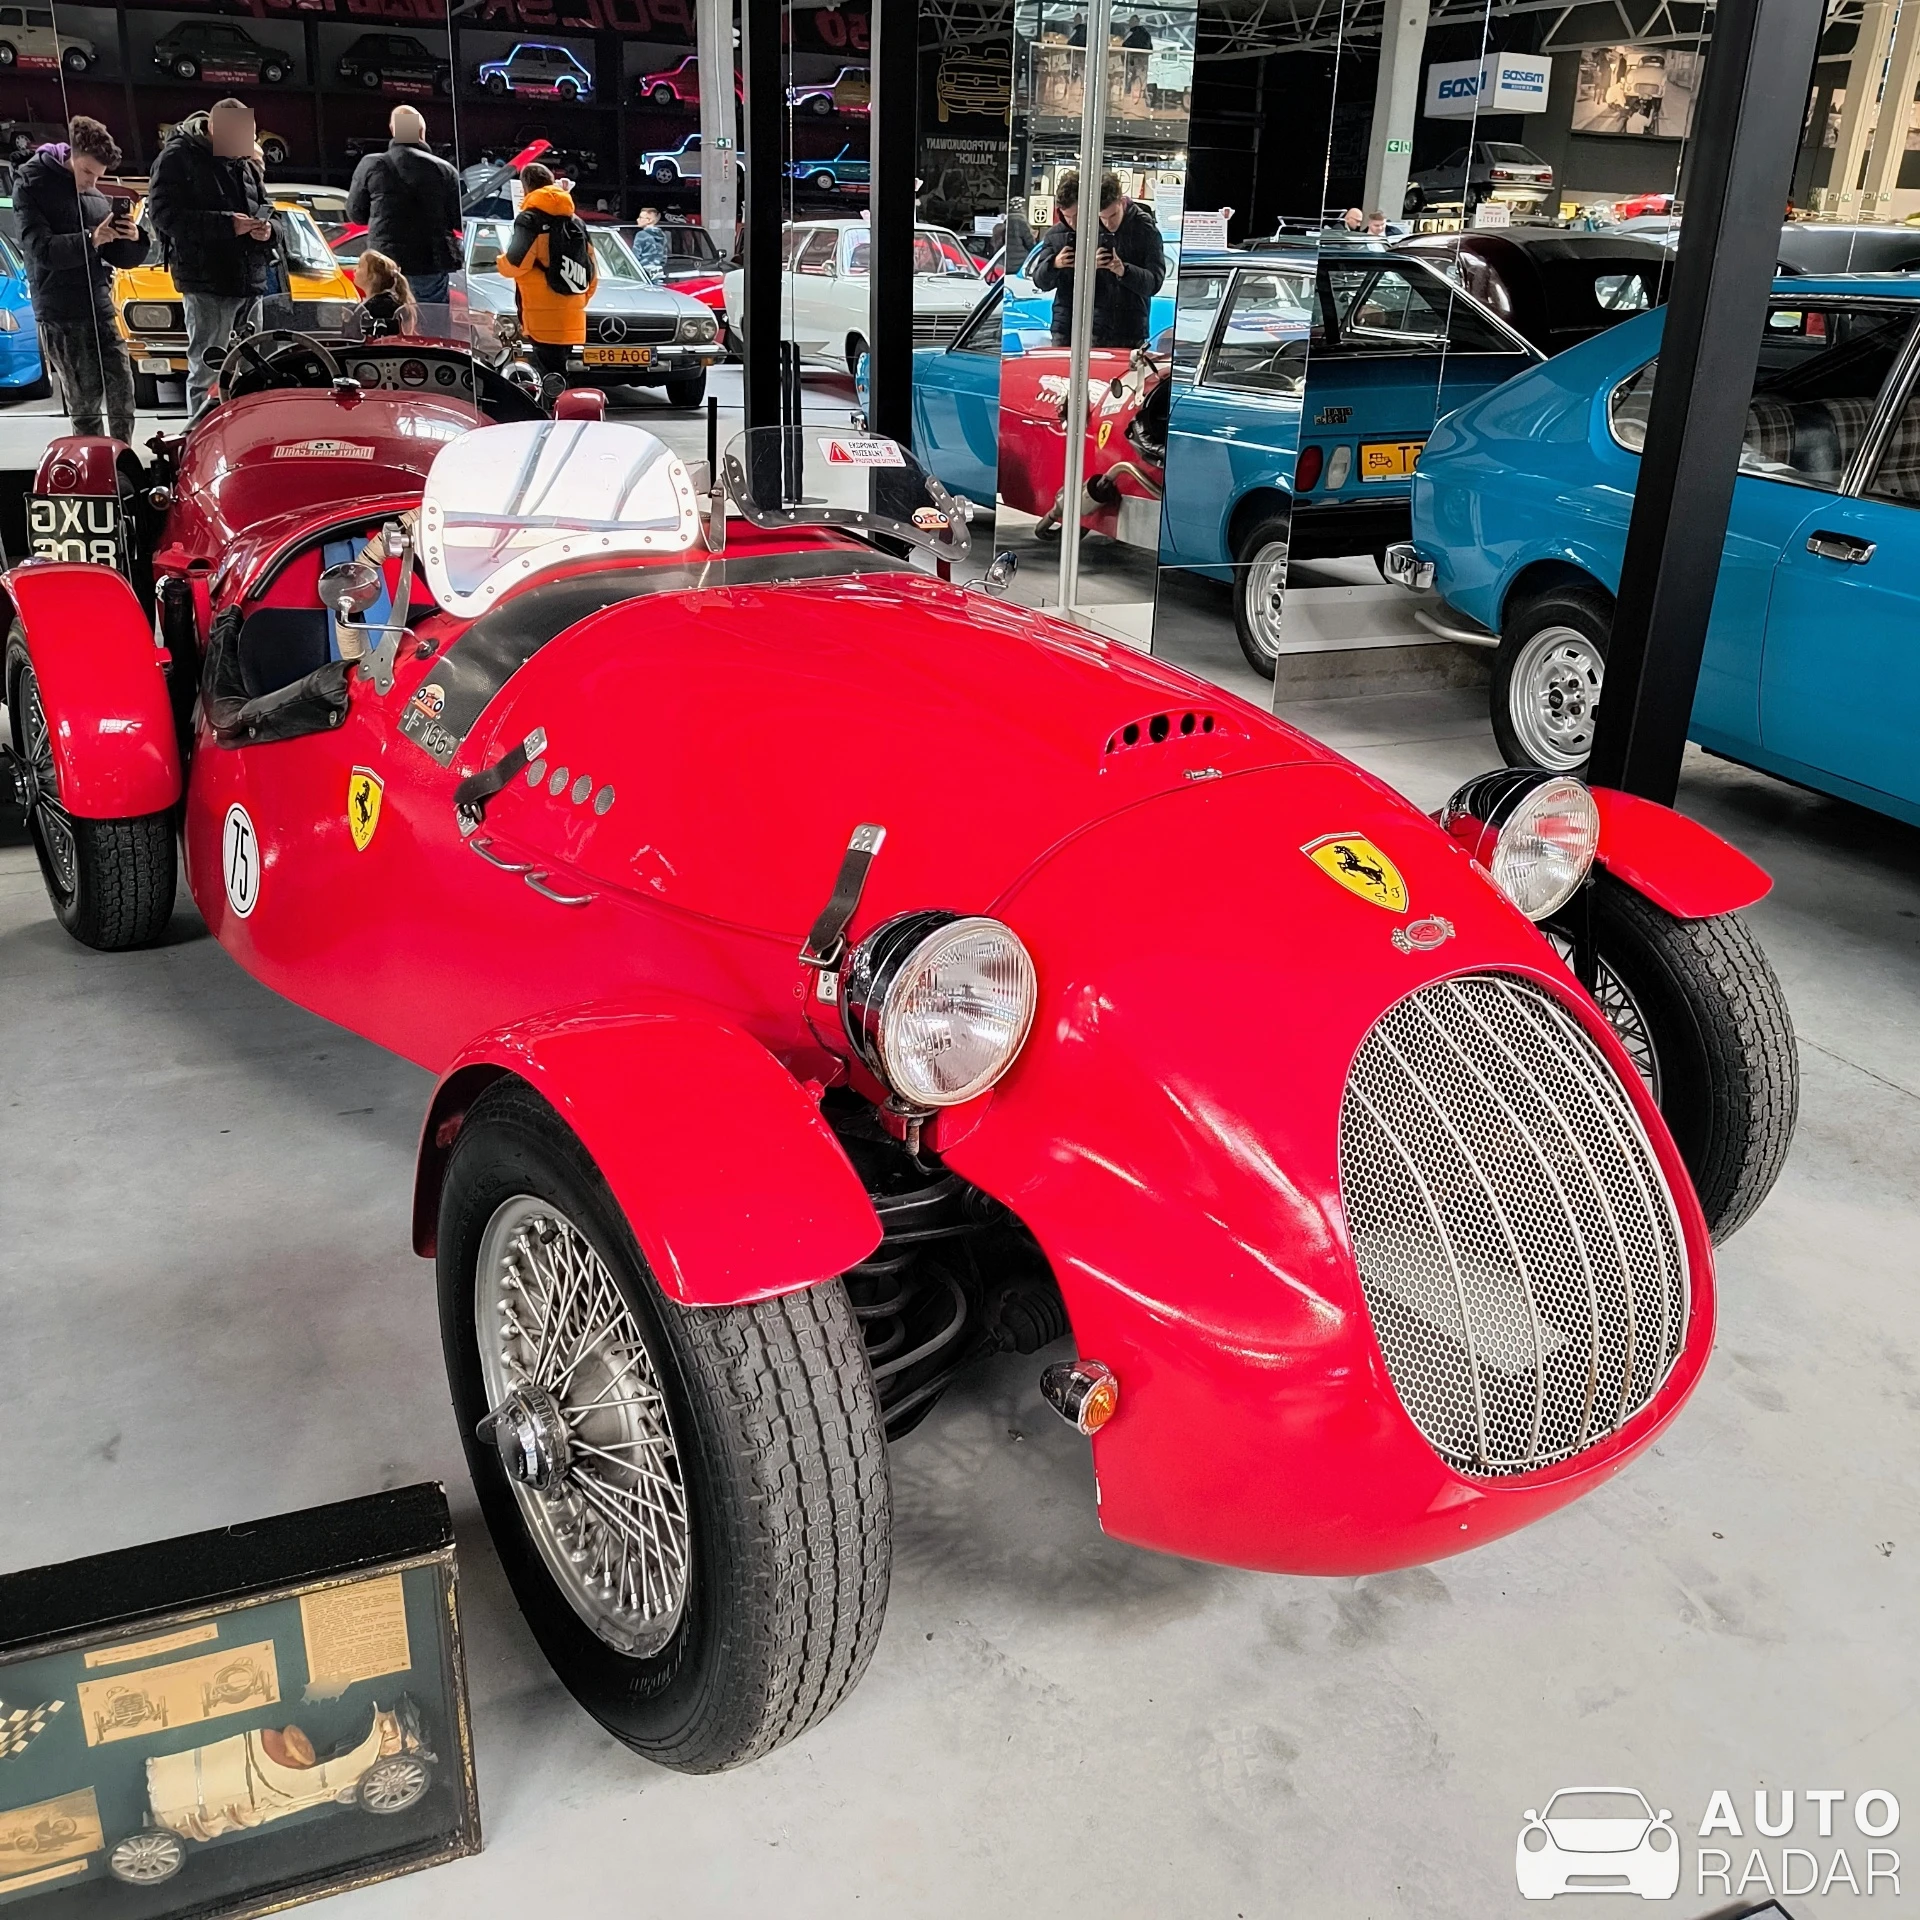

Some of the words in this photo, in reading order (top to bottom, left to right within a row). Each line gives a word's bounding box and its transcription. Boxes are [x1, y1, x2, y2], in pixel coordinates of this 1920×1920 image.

[848, 441, 880, 450] EKSPONAT
[851, 449, 883, 457] MUZEALNY
[405, 708, 424, 732] F
[421, 720, 447, 755] 166
[230, 817, 250, 902] 75
[1374, 892, 1387, 902] S
